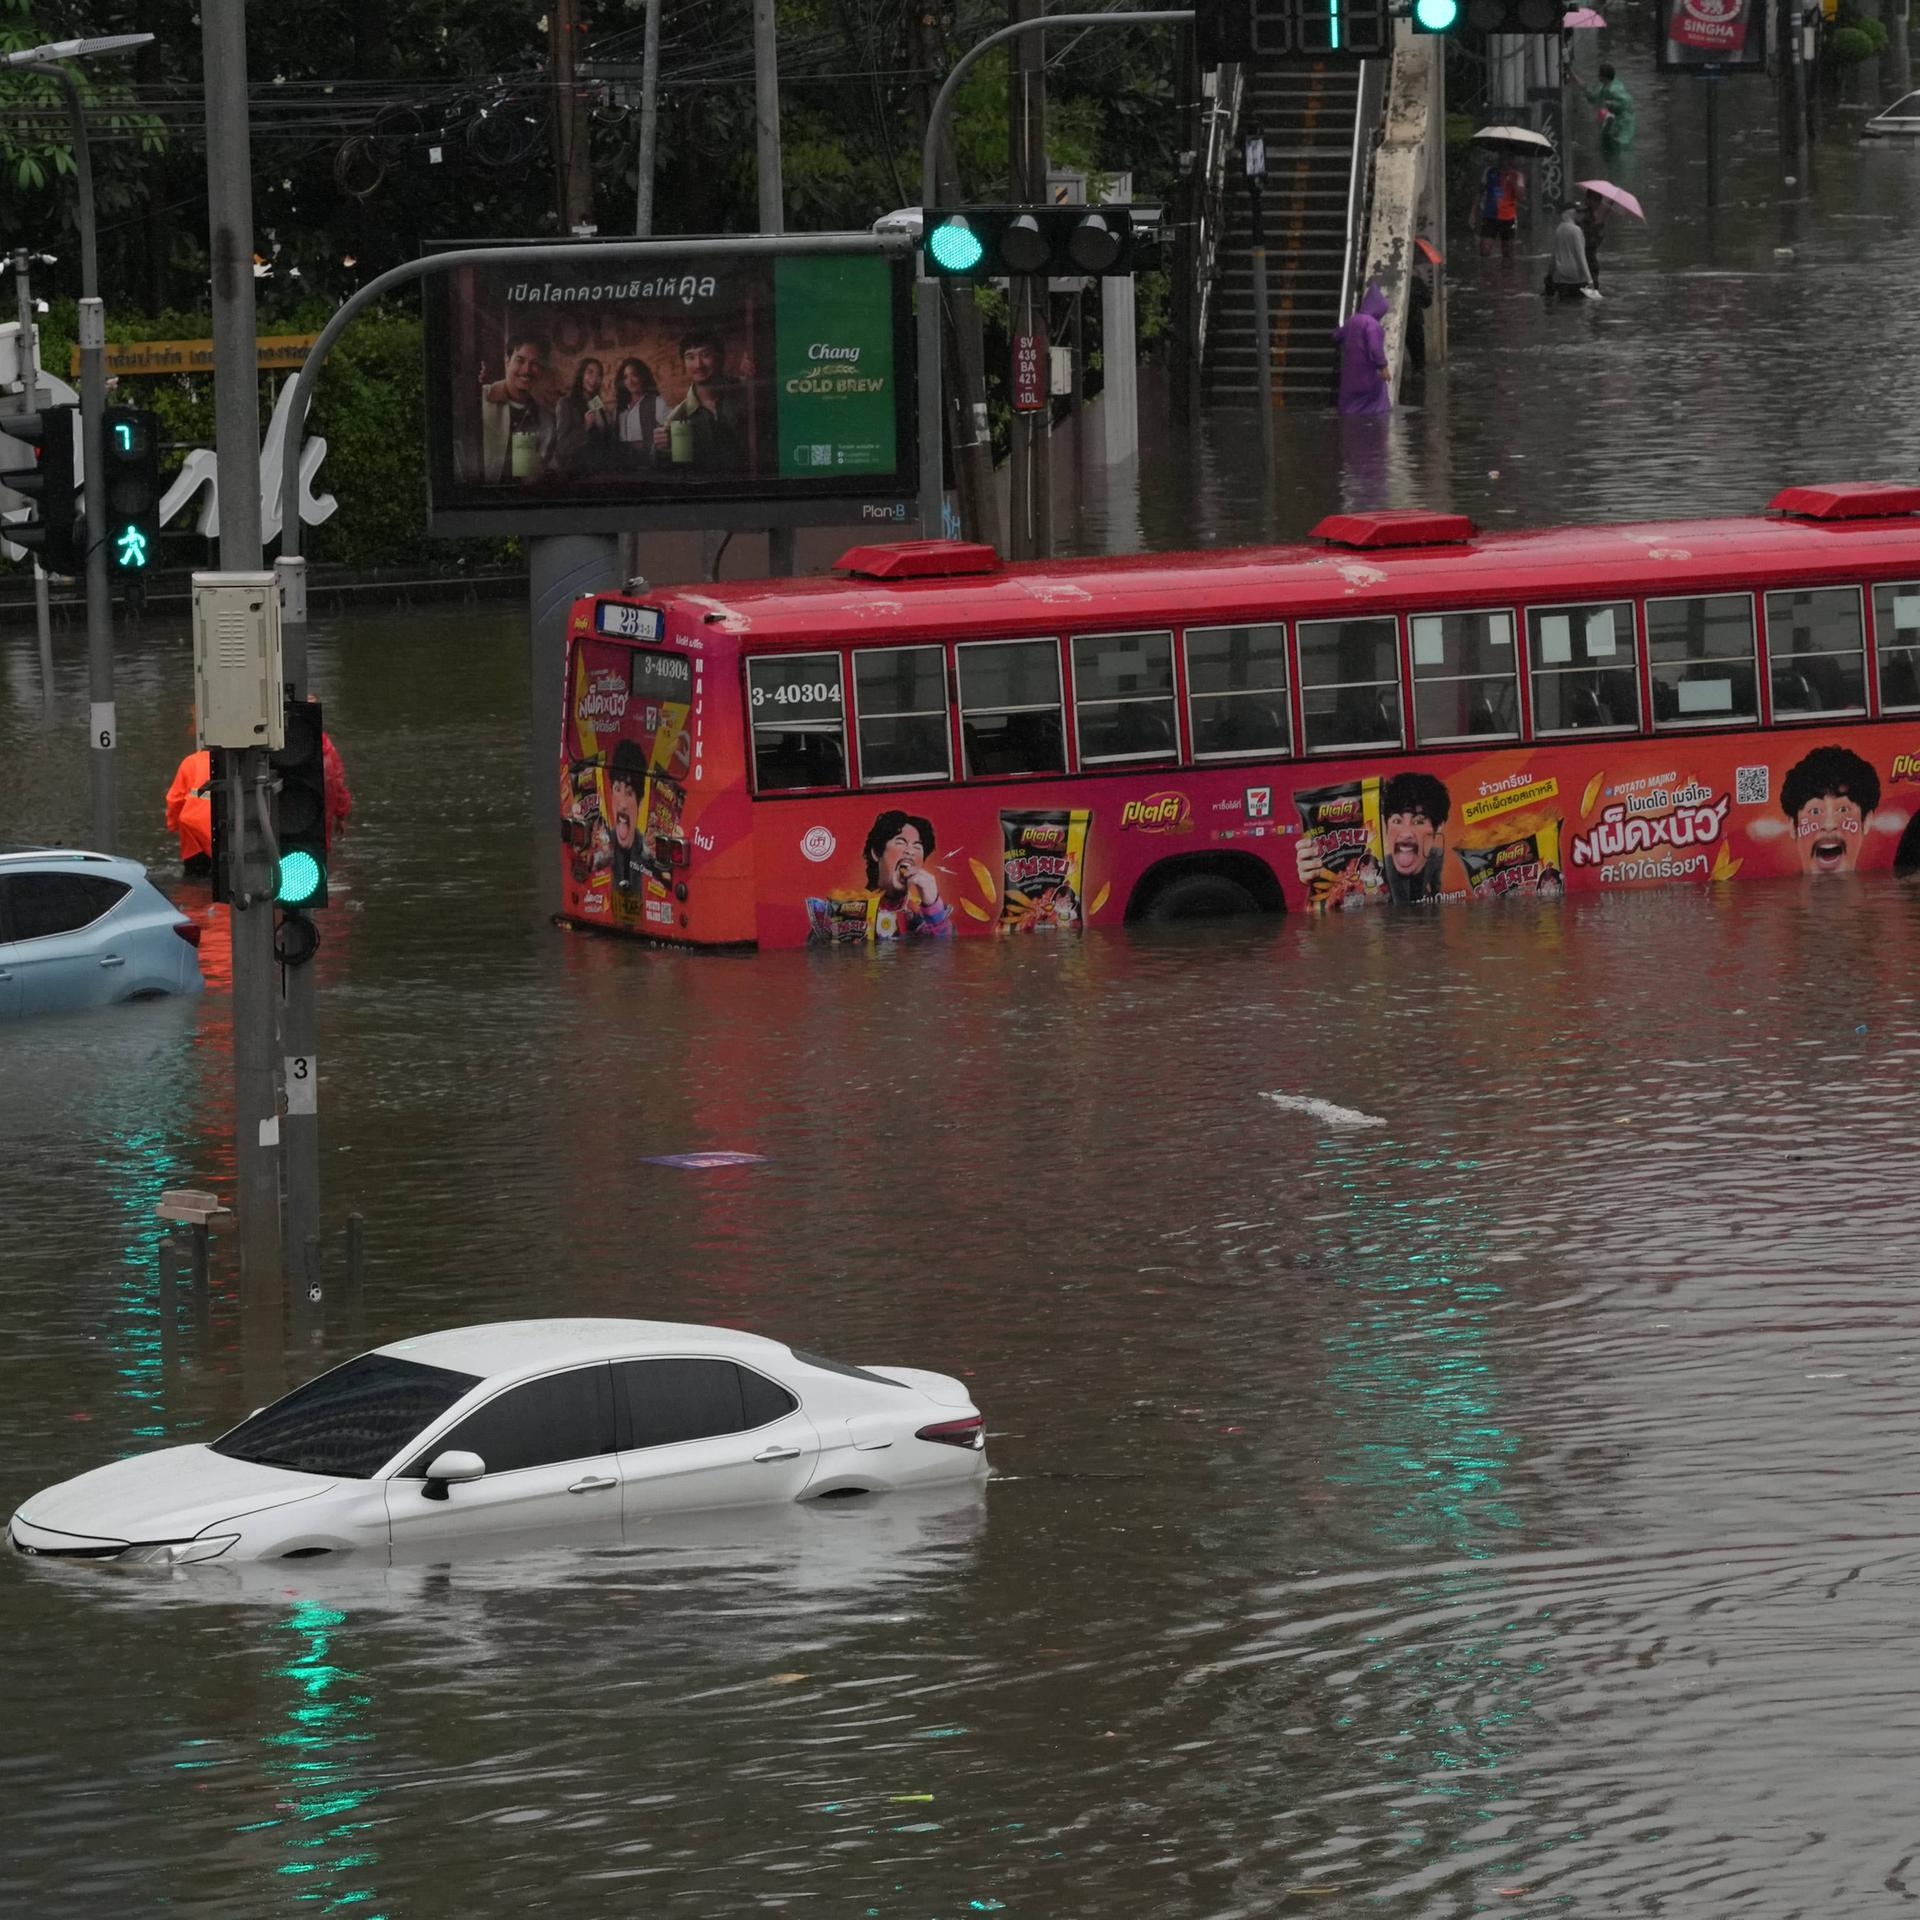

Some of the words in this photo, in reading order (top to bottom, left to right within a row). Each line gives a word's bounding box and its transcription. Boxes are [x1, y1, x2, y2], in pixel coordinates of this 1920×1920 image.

[1683, 18, 1735, 38] SINGHA
[808, 343, 860, 362] Chang
[1020, 337, 1033, 349] SV
[1018, 349, 1037, 361] 436
[1020, 361, 1035, 373] BA
[786, 379, 833, 394] COLD
[836, 378, 884, 392] BREW
[1018, 373, 1037, 385] 421
[1019, 392, 1039, 404] 1DL
[645, 656, 689, 681] 3-40304
[752, 683, 841, 706] 3-40304
[100, 730, 111, 748] 6
[1478, 773, 1533, 796] ข้าวเกรียบ
[1614, 779, 1646, 796] POTATO
[1647, 771, 1677, 788] MAJIKO
[1466, 781, 1554, 818] รสไก่เผ็ดซอสเกาหลี
[1797, 818, 1820, 838] เผ็ด
[1841, 817, 1859, 833] นัว
[1599, 851, 1709, 884] สะใจได้เรื่อยๆ
[294, 1057, 308, 1079] 3
